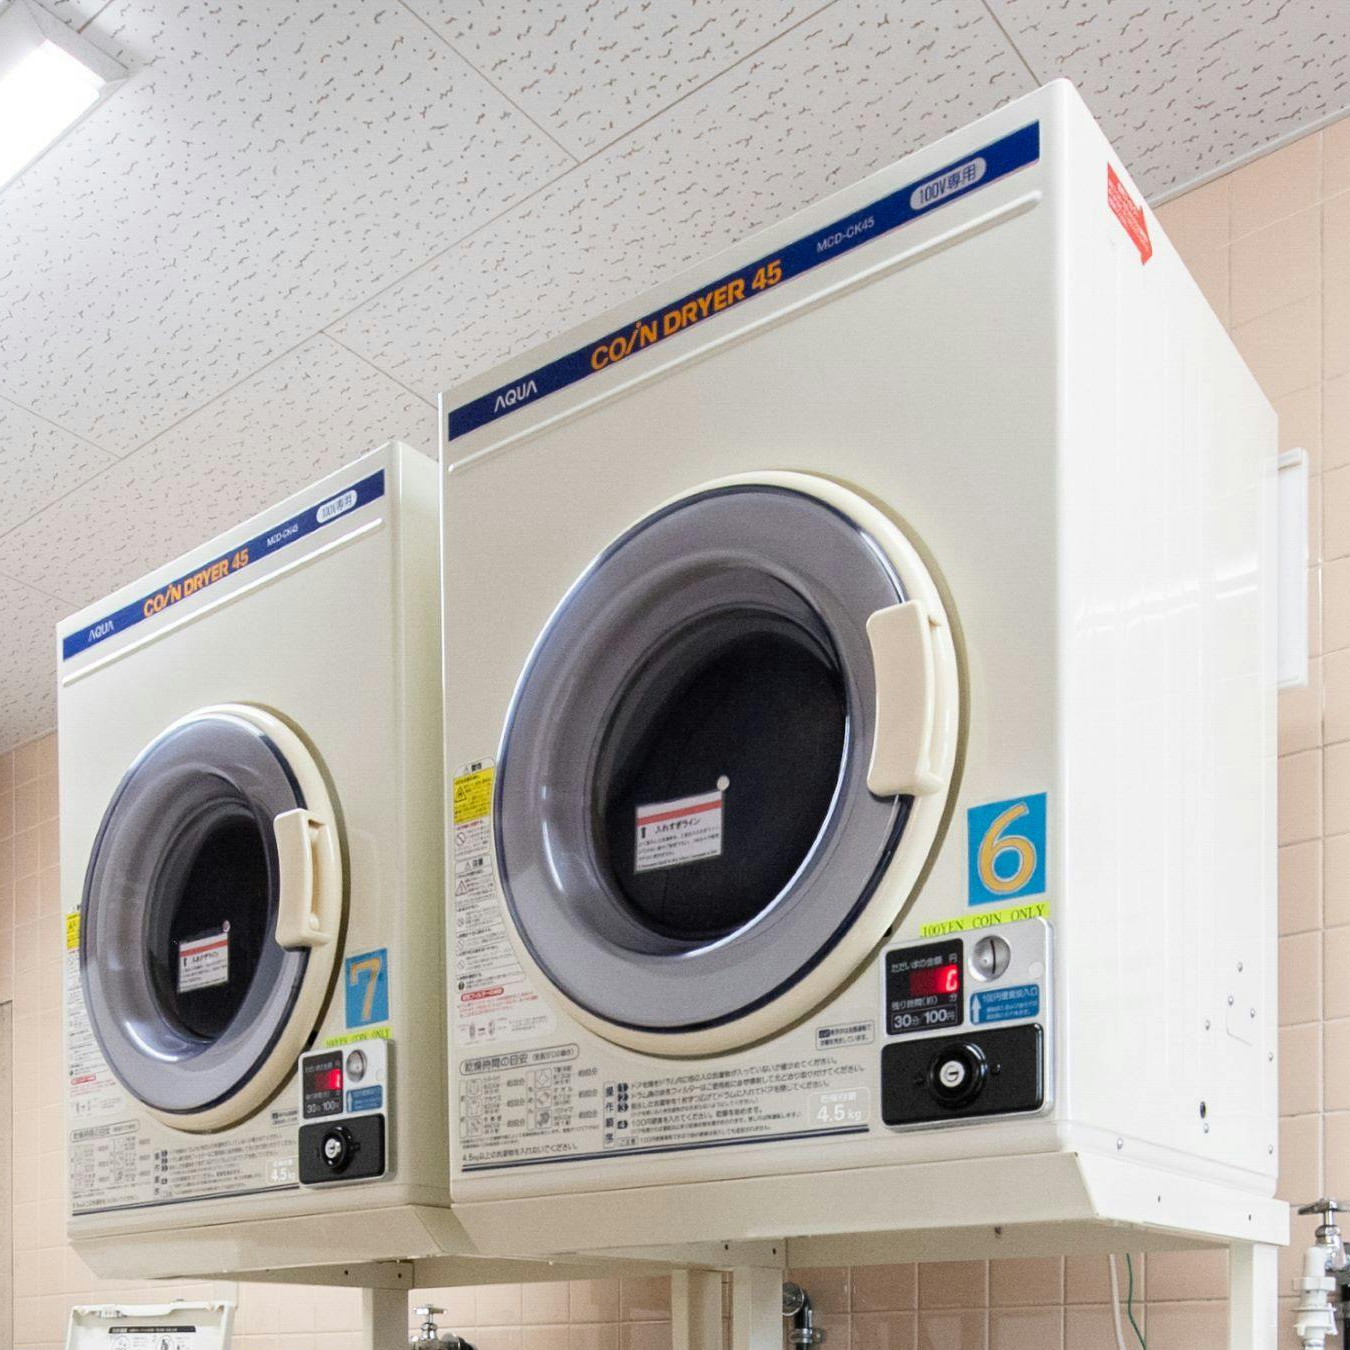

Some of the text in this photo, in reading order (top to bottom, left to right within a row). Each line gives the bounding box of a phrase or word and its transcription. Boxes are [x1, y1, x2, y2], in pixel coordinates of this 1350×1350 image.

[918, 164, 978, 206] 100V専用
[816, 215, 876, 253] MCD-CK45
[662, 277, 746, 338] DRYER
[750, 258, 784, 292] 45
[493, 379, 538, 413] AQUA
[183, 559, 230, 597] DRYER
[231, 547, 250, 570] 45
[87, 620, 115, 643] AQUA
[977, 801, 1038, 896] 6
[922, 903, 1046, 938] 100YEN COIN ONLY
[350, 957, 381, 1023] 7
[816, 1103, 862, 1122] 4.5 kg
